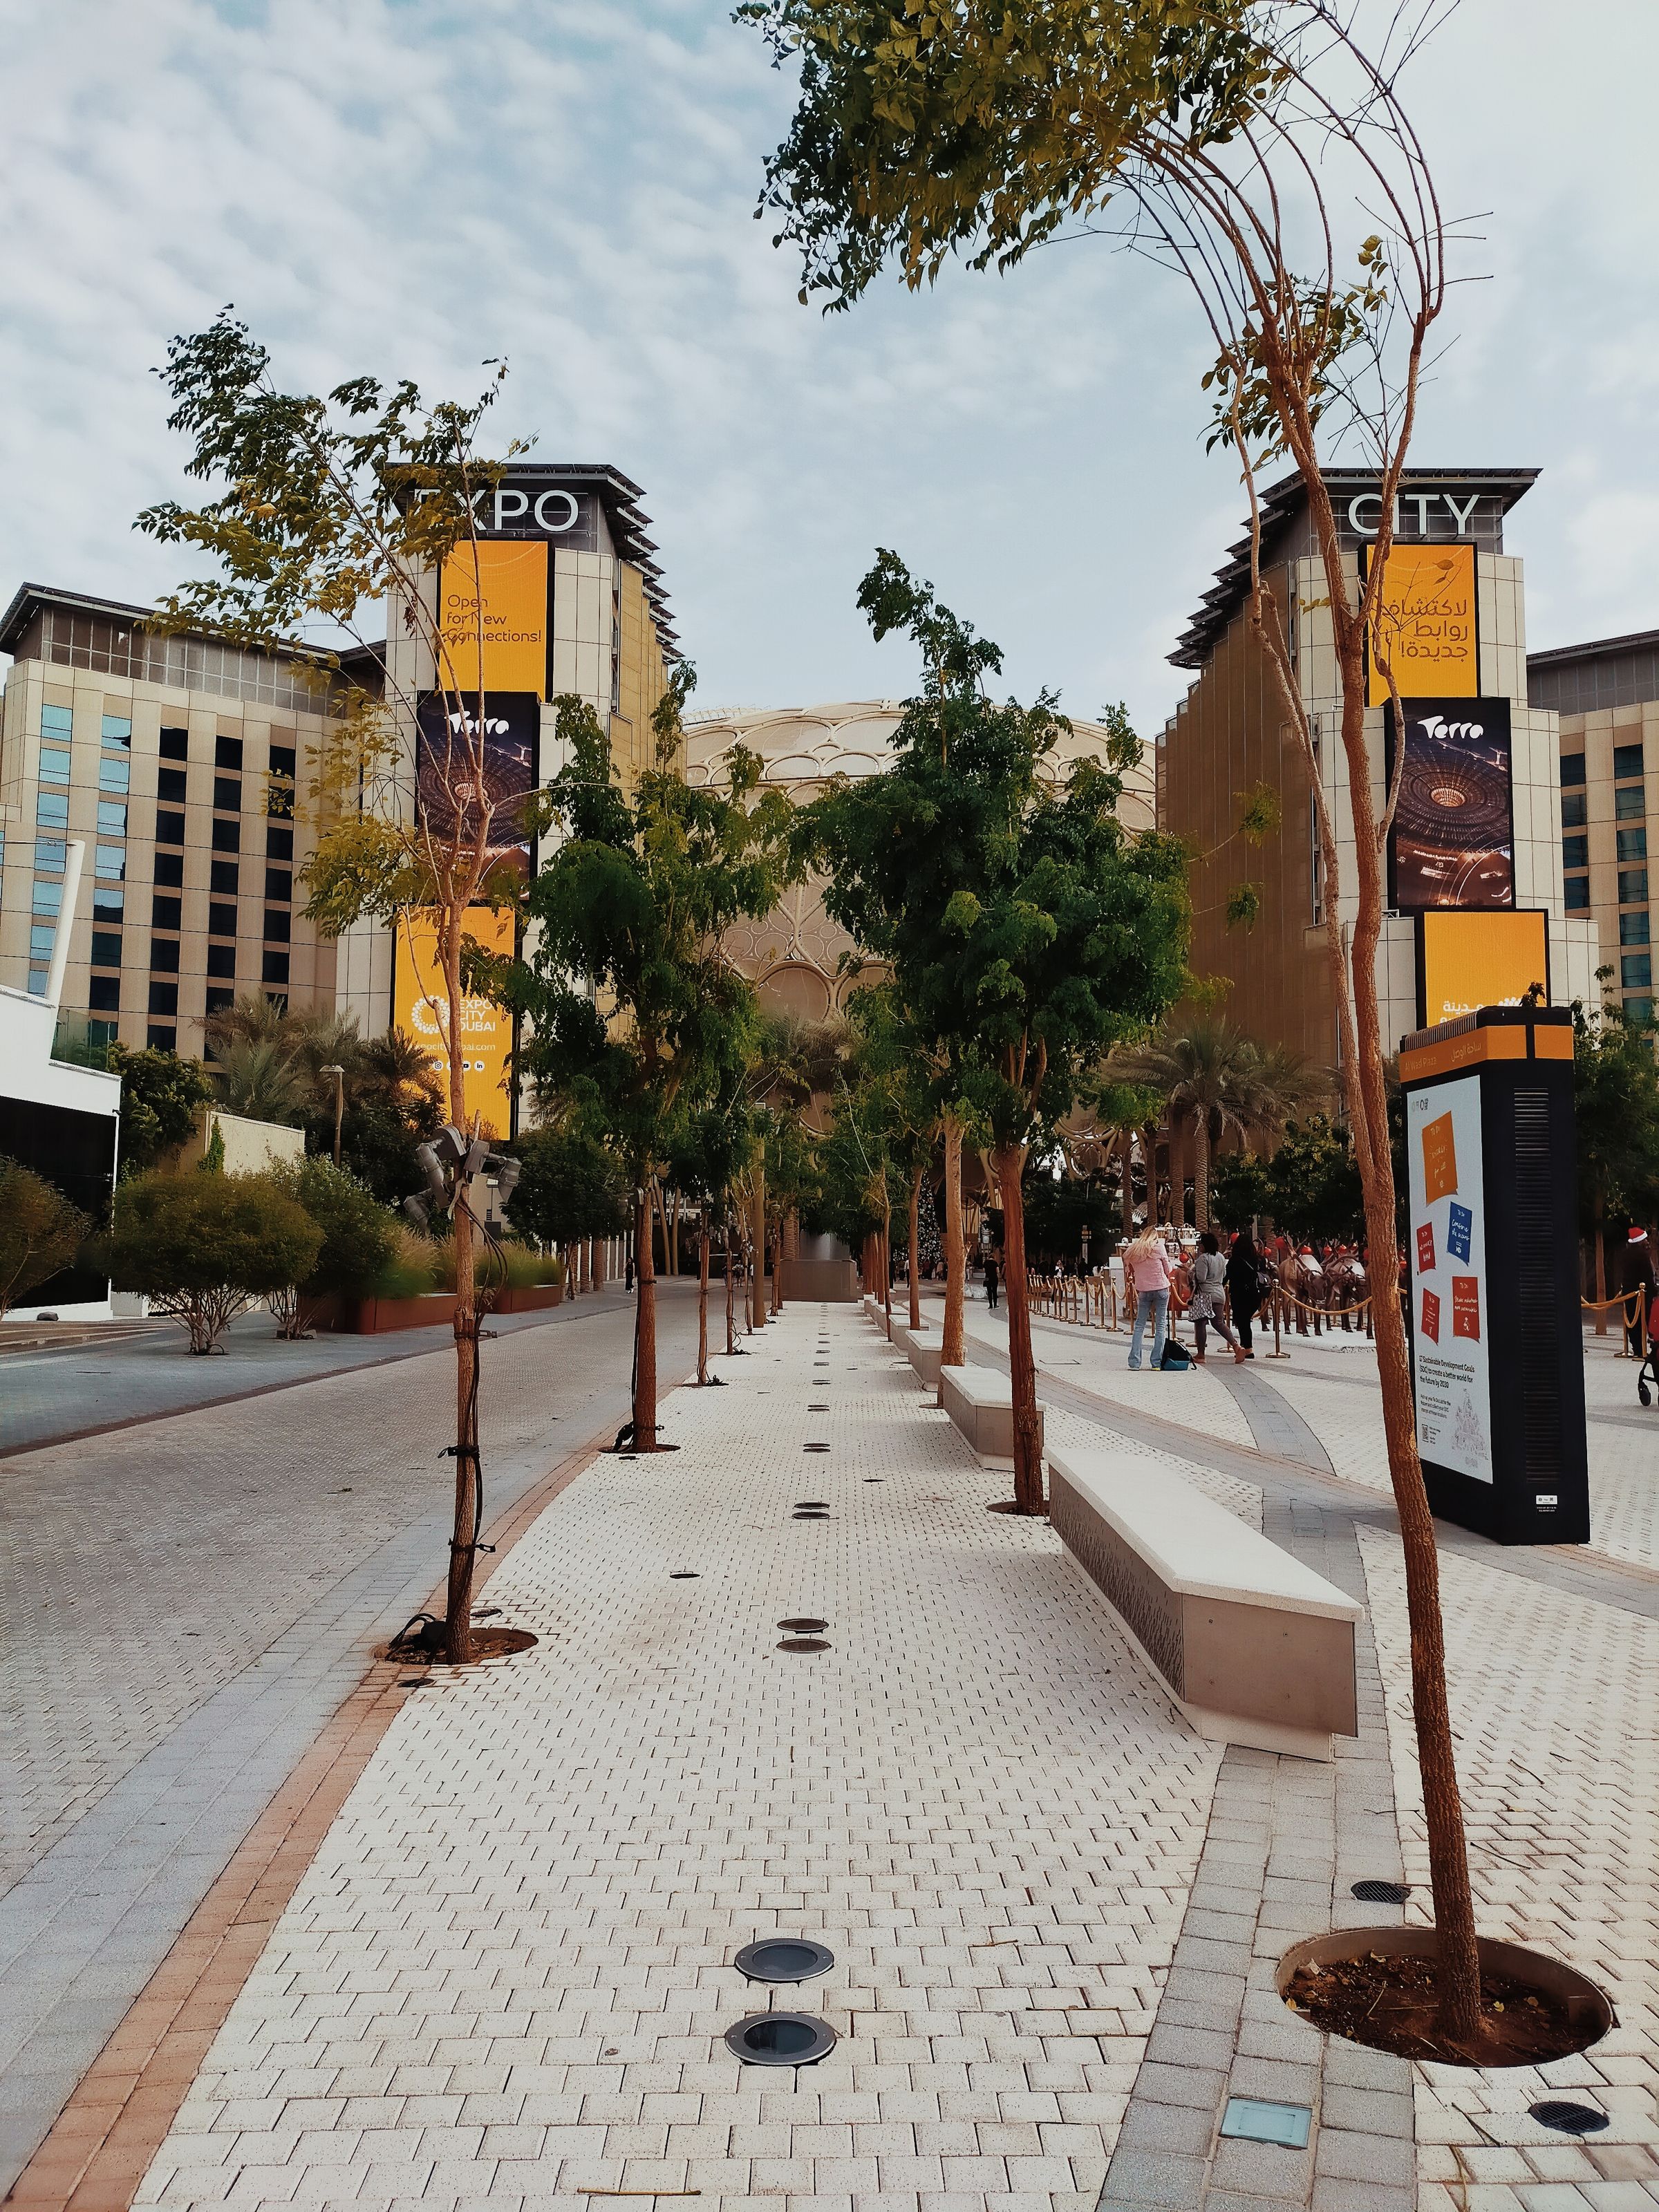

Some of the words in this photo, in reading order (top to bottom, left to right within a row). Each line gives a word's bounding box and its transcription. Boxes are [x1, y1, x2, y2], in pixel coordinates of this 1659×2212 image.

[1348, 493, 1480, 535] CITY
[447, 594, 488, 610] Open
[1382, 598, 1467, 616] لاكتشاف
[447, 612, 468, 624] for
[471, 612, 507, 624] New
[447, 627, 542, 642] Connections!
[1413, 620, 1468, 641] روابط
[1401, 641, 1468, 662] جديدة!
[1417, 715, 1484, 739] Terra
[1423, 1356, 1441, 1366] Sustainable
[1441, 1360, 1464, 1371] Development
[1463, 1364, 1475, 1373] Goals
[1456, 1374, 1467, 1382] world
